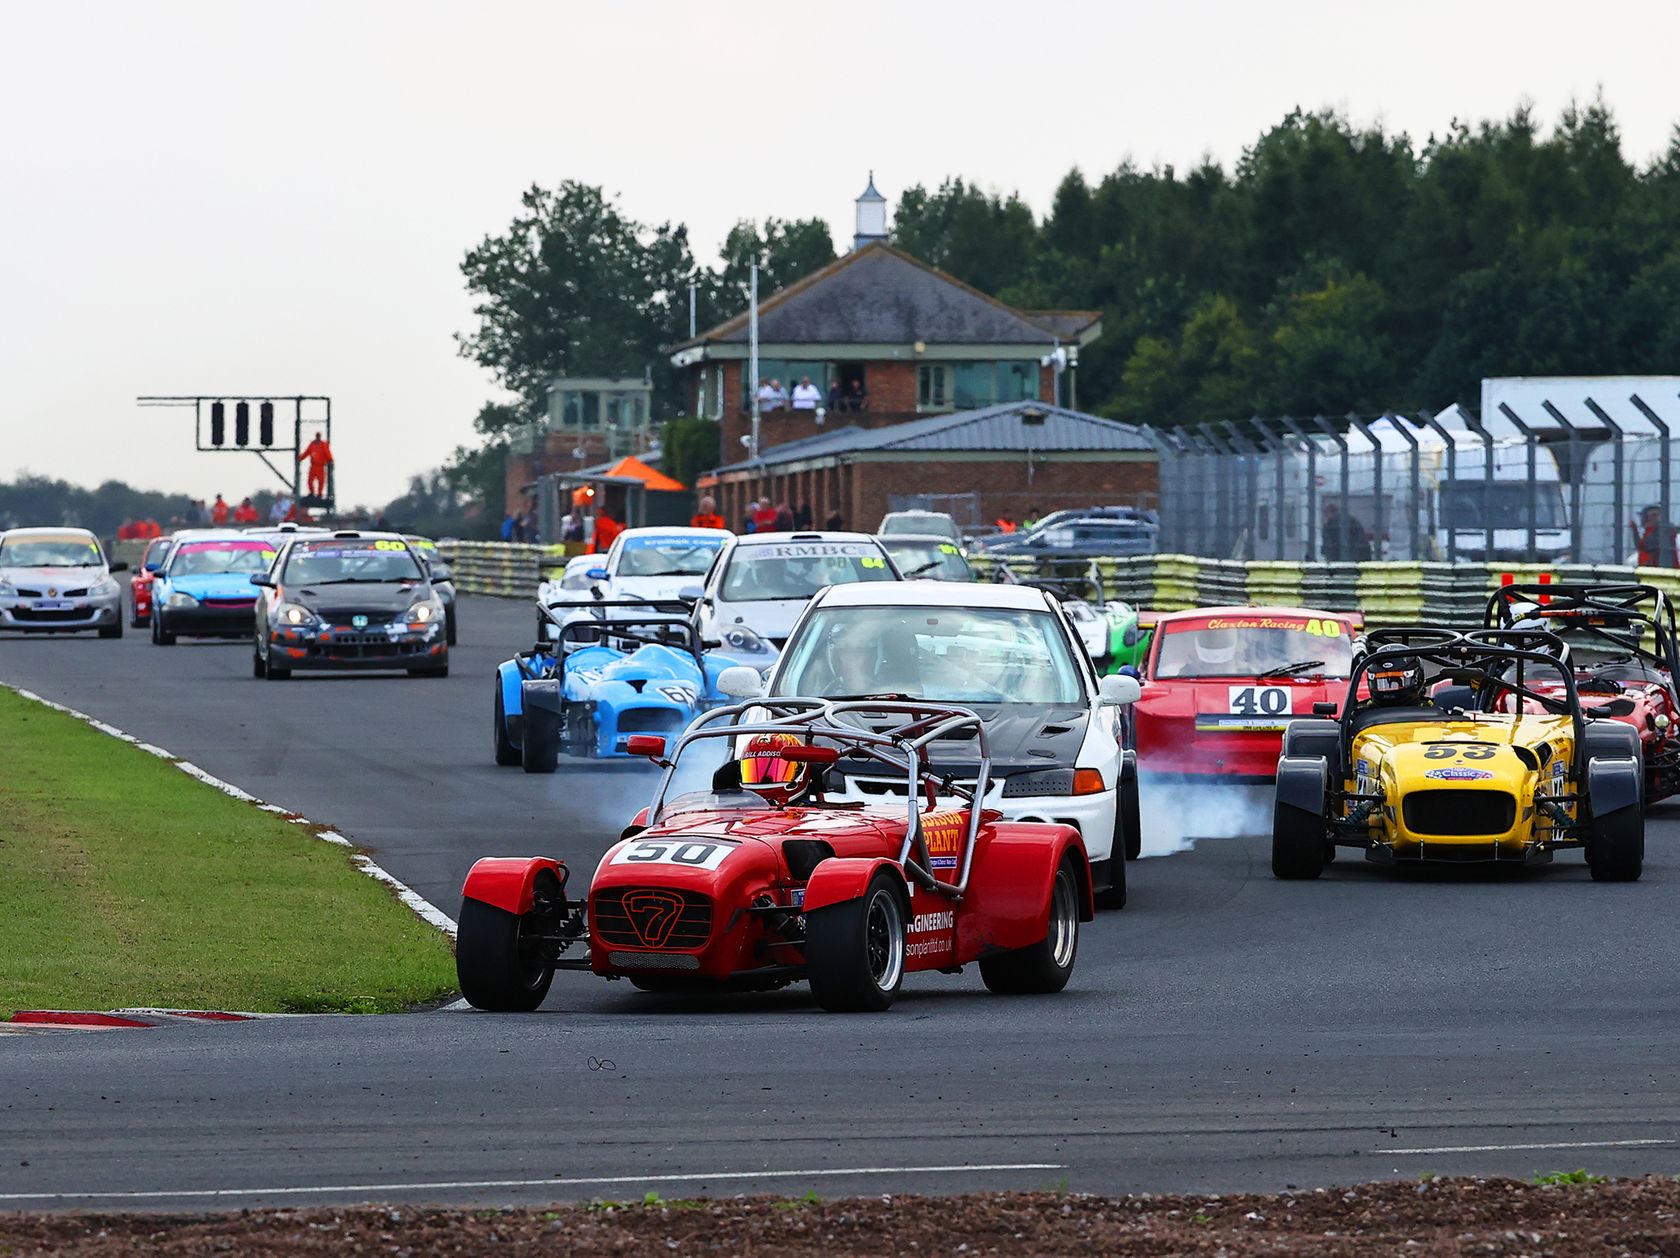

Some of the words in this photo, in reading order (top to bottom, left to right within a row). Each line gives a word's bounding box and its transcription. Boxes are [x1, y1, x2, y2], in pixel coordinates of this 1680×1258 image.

[374, 539, 406, 552] 60
[776, 544, 859, 557] RMBC
[1207, 619, 1257, 630] Claxton
[1259, 618, 1305, 632] Racing
[1305, 618, 1341, 638] 40
[1232, 687, 1288, 715] 40
[1423, 744, 1497, 760] 53
[1441, 769, 1477, 778] Classic
[923, 828, 959, 852] PLANT
[627, 842, 718, 865] 50
[631, 897, 677, 940] 7
